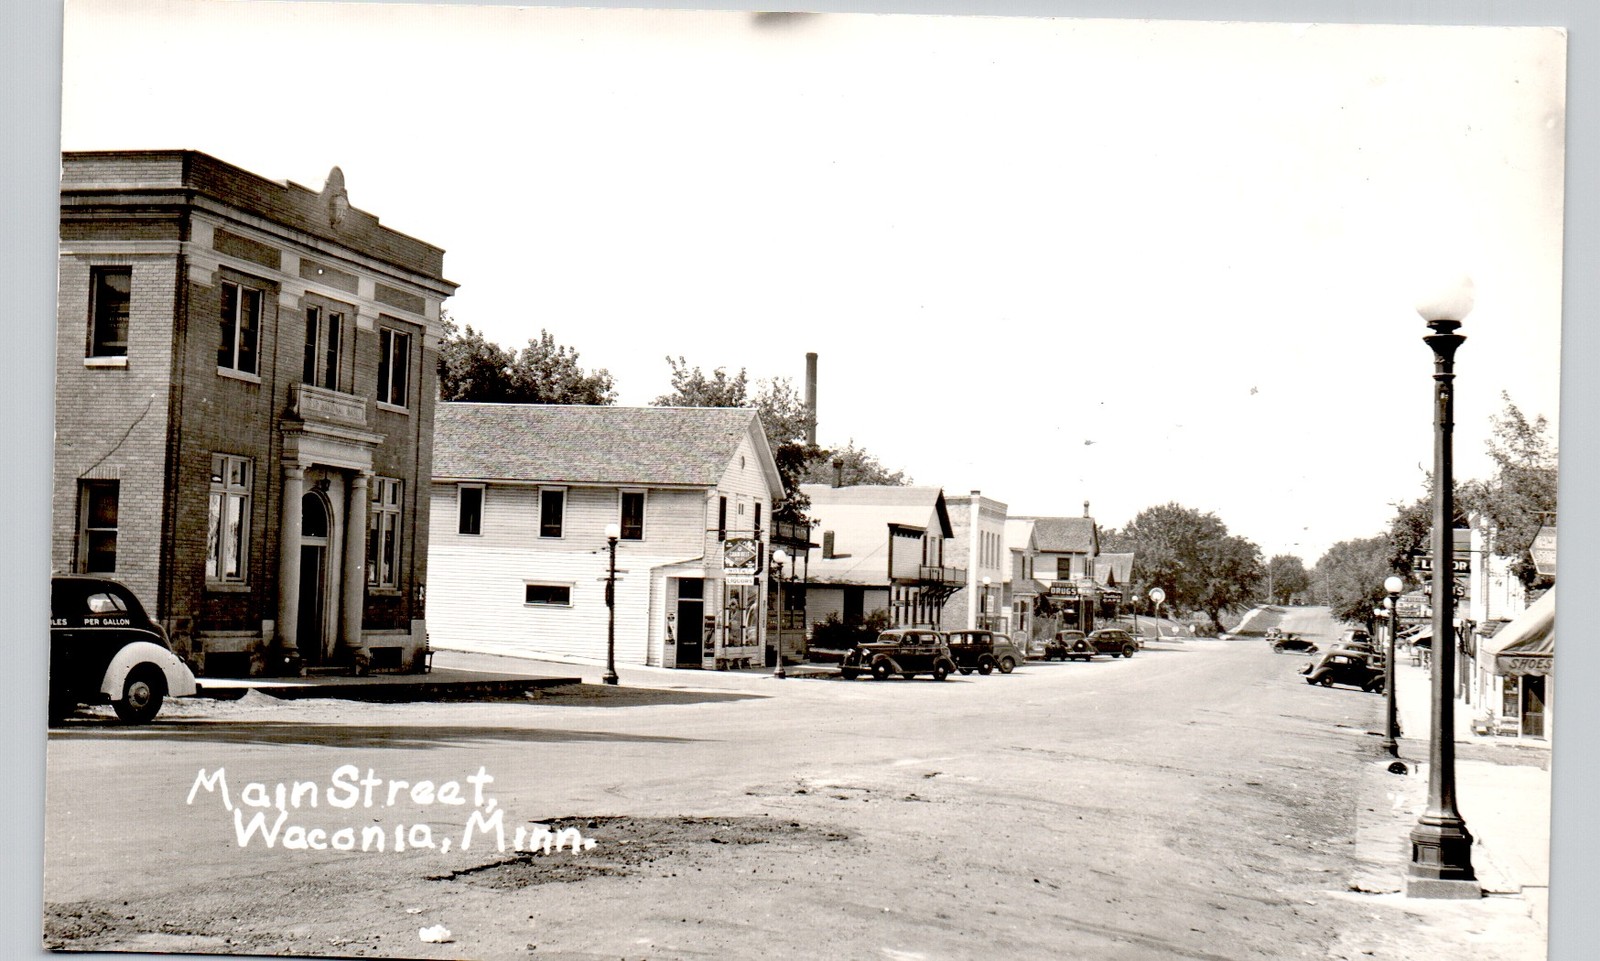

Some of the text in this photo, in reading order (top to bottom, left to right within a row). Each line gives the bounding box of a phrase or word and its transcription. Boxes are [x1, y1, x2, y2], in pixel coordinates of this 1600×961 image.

[1421, 559, 1468, 570] LIOR
[1050, 587, 1077, 595] DRUGS
[1509, 658, 1552, 669] SHOES
